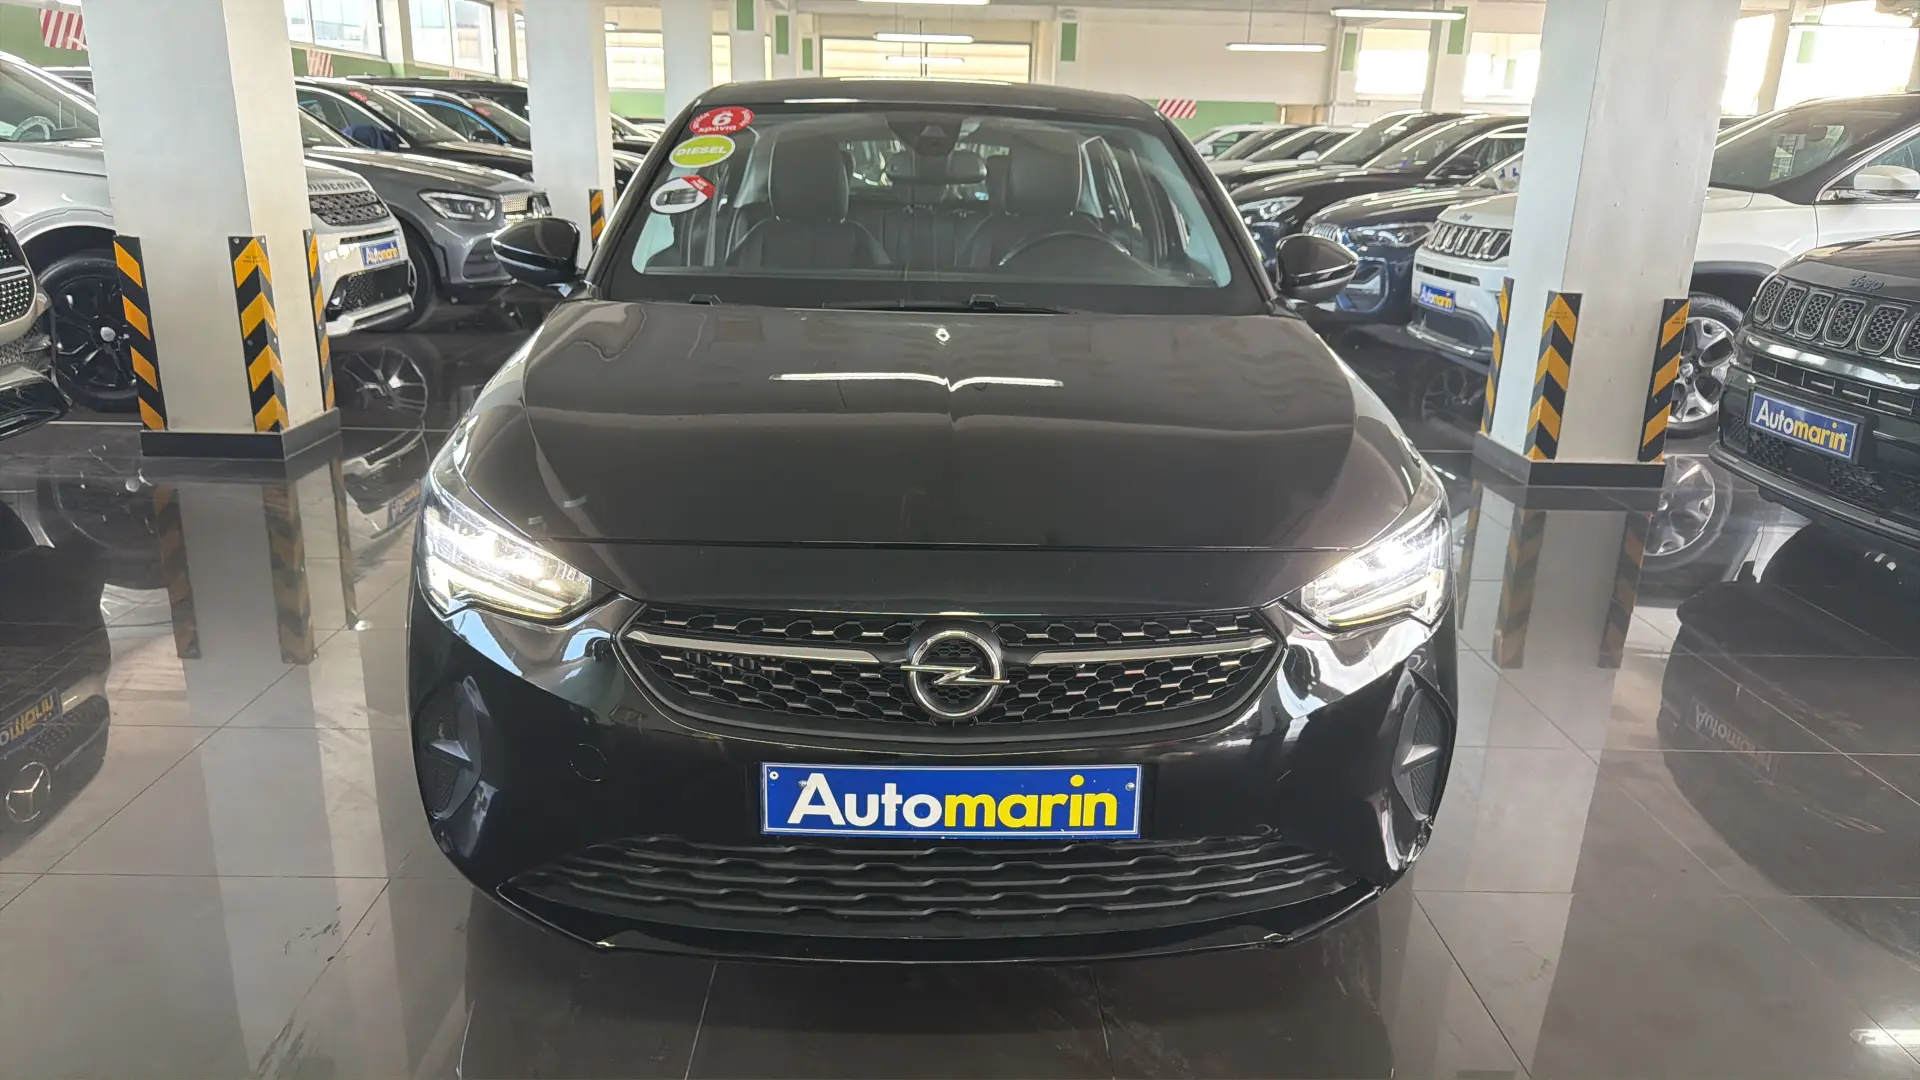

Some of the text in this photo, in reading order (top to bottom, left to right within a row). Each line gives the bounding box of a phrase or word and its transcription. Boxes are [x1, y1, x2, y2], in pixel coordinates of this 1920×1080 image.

[711, 110, 734, 126] 6
[676, 145, 727, 156] DIESEL
[1850, 275, 1885, 292] Jeep
[1755, 399, 1848, 452] Automarin
[787, 772, 1117, 828] Automarin
